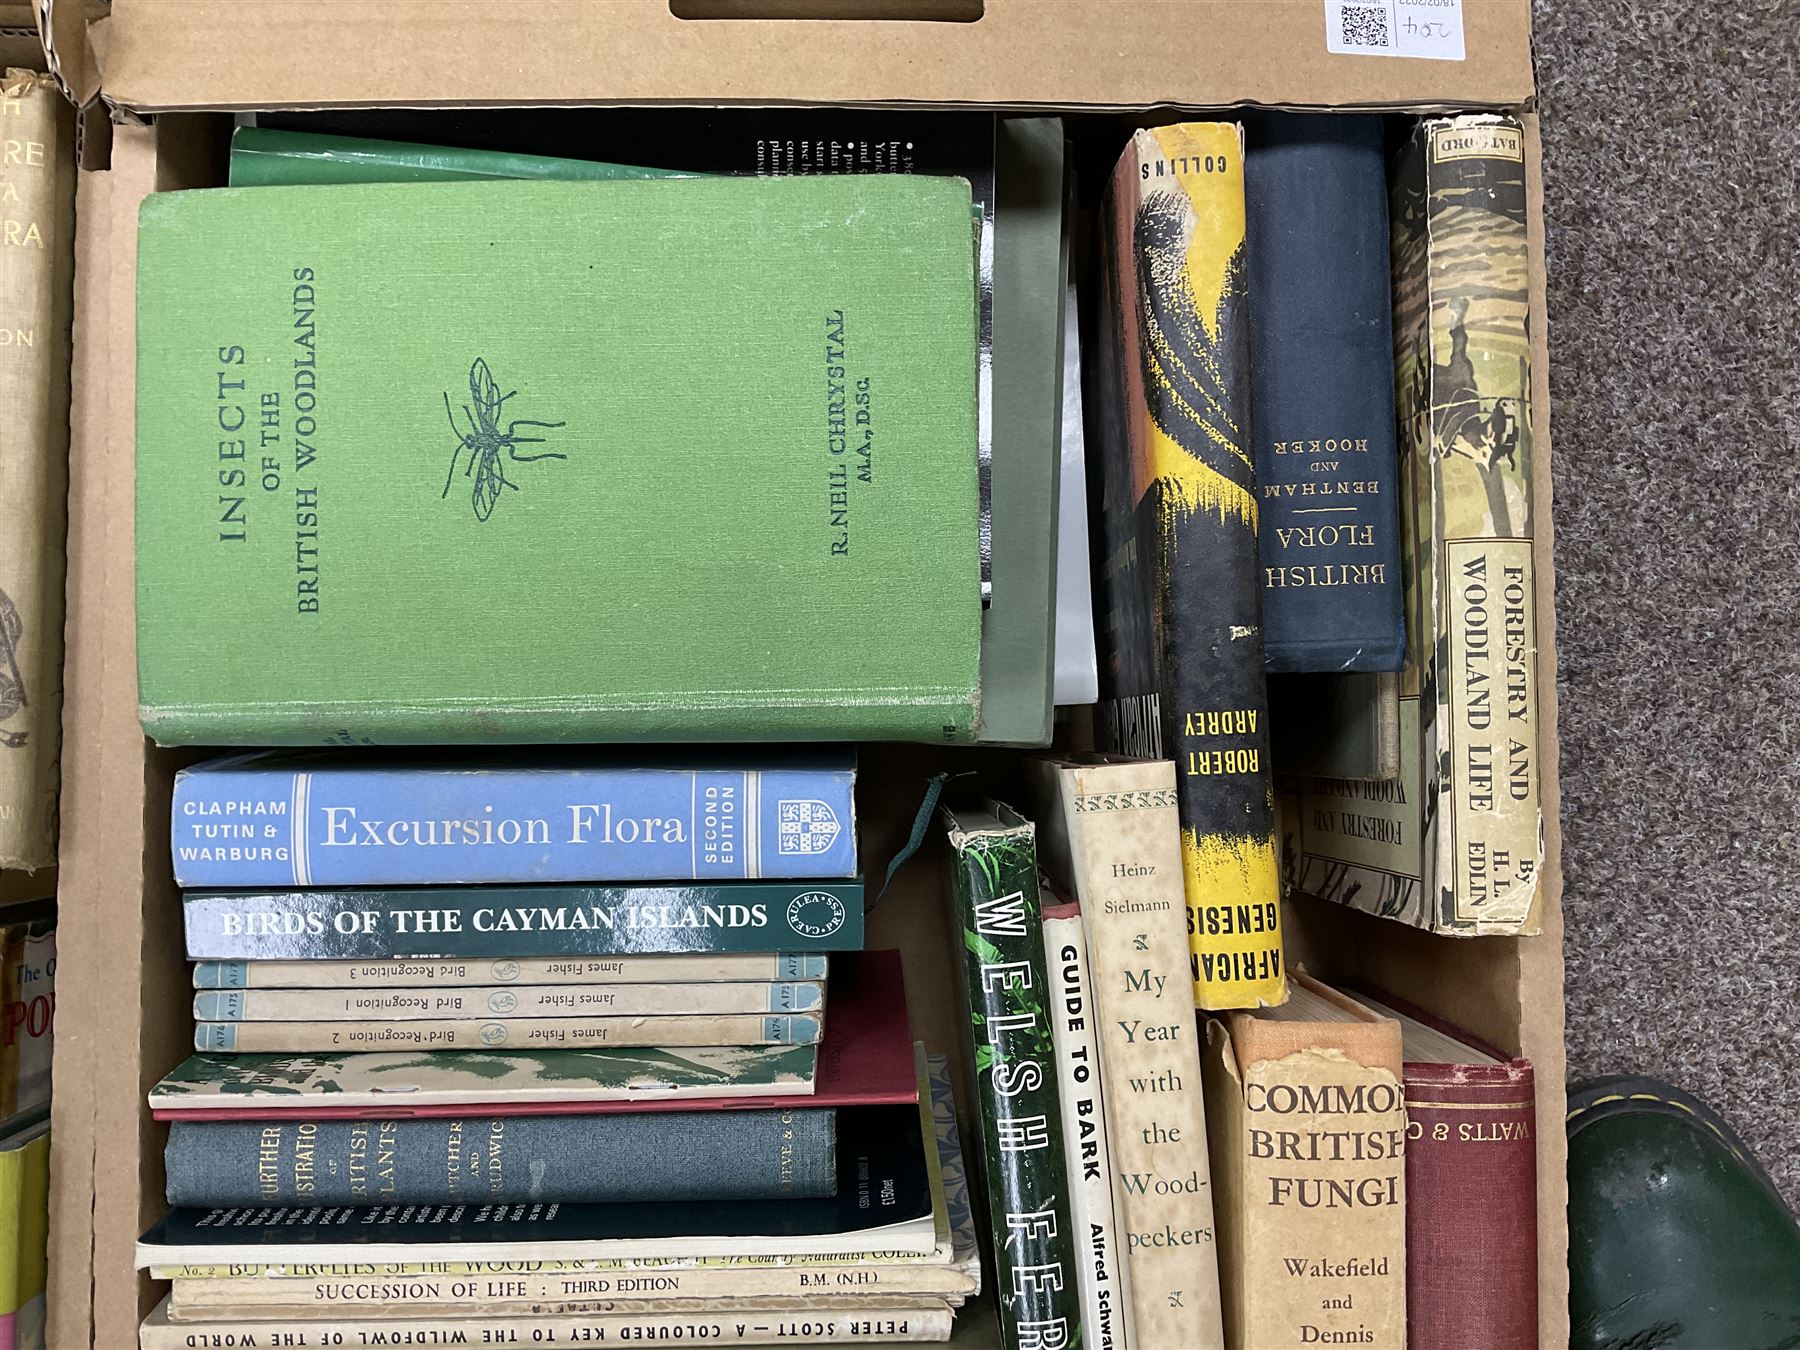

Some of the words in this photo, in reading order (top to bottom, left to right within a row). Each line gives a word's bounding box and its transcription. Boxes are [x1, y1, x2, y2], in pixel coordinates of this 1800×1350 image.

[4, 140, 45, 167] RE
[801, 142, 809, 160] use
[816, 142, 824, 166] start
[831, 142, 842, 166] data
[860, 142, 871, 163] and
[1441, 138, 1516, 152] BATORD
[769, 141, 783, 177] plann
[876, 142, 886, 174] York
[1141, 156, 1226, 180] COLLINS
[4, 219, 44, 248] RA
[293, 267, 317, 473] WOODLANDS
[827, 310, 846, 455] CHRYSTAL
[261, 392, 280, 447] THE
[217, 345, 246, 542] INSECTS
[1274, 439, 1367, 455] HOOKER
[262, 458, 280, 492] OF
[1310, 461, 1339, 472] AND
[1264, 481, 1379, 498] BENTHAM
[1276, 525, 1375, 549] FLORA
[296, 487, 319, 614] BRITISH
[1265, 564, 1386, 588] BRITISH
[1463, 553, 1491, 731] WOODLAND
[1503, 564, 1528, 725] FORESTRY
[1185, 710, 1258, 736] ARDREY
[1187, 749, 1259, 775] ROBERT
[1508, 737, 1531, 801] AND
[1468, 744, 1493, 812] LIFE
[183, 802, 286, 816] CLAPHAM
[192, 824, 254, 839] TUTIN
[264, 824, 278, 838] &
[320, 804, 552, 847] Excursion
[566, 803, 687, 844] Flora
[705, 786, 717, 864] SECOND
[721, 787, 734, 864] EDITION
[1341, 812, 1402, 846] FORESTRY
[179, 847, 289, 861] WARBURG
[1112, 863, 1156, 878] Heinz
[1468, 840, 1488, 907] EDLIN
[790, 894, 820, 935] CAERULEA
[824, 897, 842, 932] PRESS
[1104, 899, 1171, 914] Sielmann
[1186, 902, 1276, 935] GENESIS
[221, 911, 324, 937] BIRDS
[334, 910, 379, 934] OF
[390, 909, 463, 933] THE
[472, 906, 616, 932] CAYMAN
[627, 904, 768, 929] ISLANDS
[350, 967, 356, 979] 3
[362, 966, 435, 979] Recognition
[440, 965, 465, 978] Bird
[547, 963, 583, 975] Fisher
[587, 962, 623, 975] James
[1191, 948, 1280, 983] AFRICAN
[1061, 944, 1085, 1032] GUIDE
[1123, 968, 1167, 998] My
[356, 998, 429, 1010] Recognition
[436, 997, 462, 1009] Bird
[538, 995, 575, 1007] Fisher
[580, 994, 615, 1007] James
[4, 992, 56, 1047] PO
[975, 890, 1049, 1152] WELSH
[332, 1032, 339, 1044] 2
[350, 1031, 422, 1044] Recognition
[431, 1030, 455, 1042] Bird
[528, 1030, 565, 1042] Fisher
[573, 1029, 607, 1041] James
[1117, 1020, 1180, 1044] Year
[1071, 1046, 1089, 1083] TO
[1129, 1069, 1183, 1093] with
[1077, 1098, 1101, 1182] BARK
[1142, 1122, 1181, 1145] the
[1408, 1121, 1423, 1141] C
[1432, 1122, 1449, 1141] &
[1460, 1121, 1529, 1141] WATTS
[378, 1121, 398, 1197] LANTS
[471, 1152, 480, 1177] AND
[1121, 1171, 1207, 1196] Wood-
[1268, 1176, 1398, 1208] FUNGI
[1127, 1225, 1212, 1255] peckers
[1090, 1223, 1109, 1282] Alfred
[179, 1264, 202, 1276] No.
[208, 1266, 215, 1276] 2
[1284, 1257, 1389, 1277] Wakefield
[315, 1283, 440, 1300] SUCCESSION
[452, 1283, 477, 1298] OF
[488, 1281, 527, 1297] LIFE
[561, 1279, 610, 1294] THIRD
[617, 1277, 680, 1292] EDITION
[800, 1274, 831, 1287] B.M.
[1322, 1294, 1353, 1309] and
[271, 1333, 306, 1346] THE
[320, 1332, 343, 1346] OF
[359, 1330, 467, 1345] WILDFOWL
[483, 1328, 518, 1343] THE
[532, 1328, 555, 1342] TO
[570, 1327, 605, 1342] KEY
[620, 1325, 721, 1341] COLOURED
[736, 1324, 746, 1337] A
[777, 1321, 835, 1336] SCOTT
[850, 1320, 908, 1335] PETER
[1300, 1325, 1374, 1344] Dennis
[186, 1334, 256, 1347] WORLD
